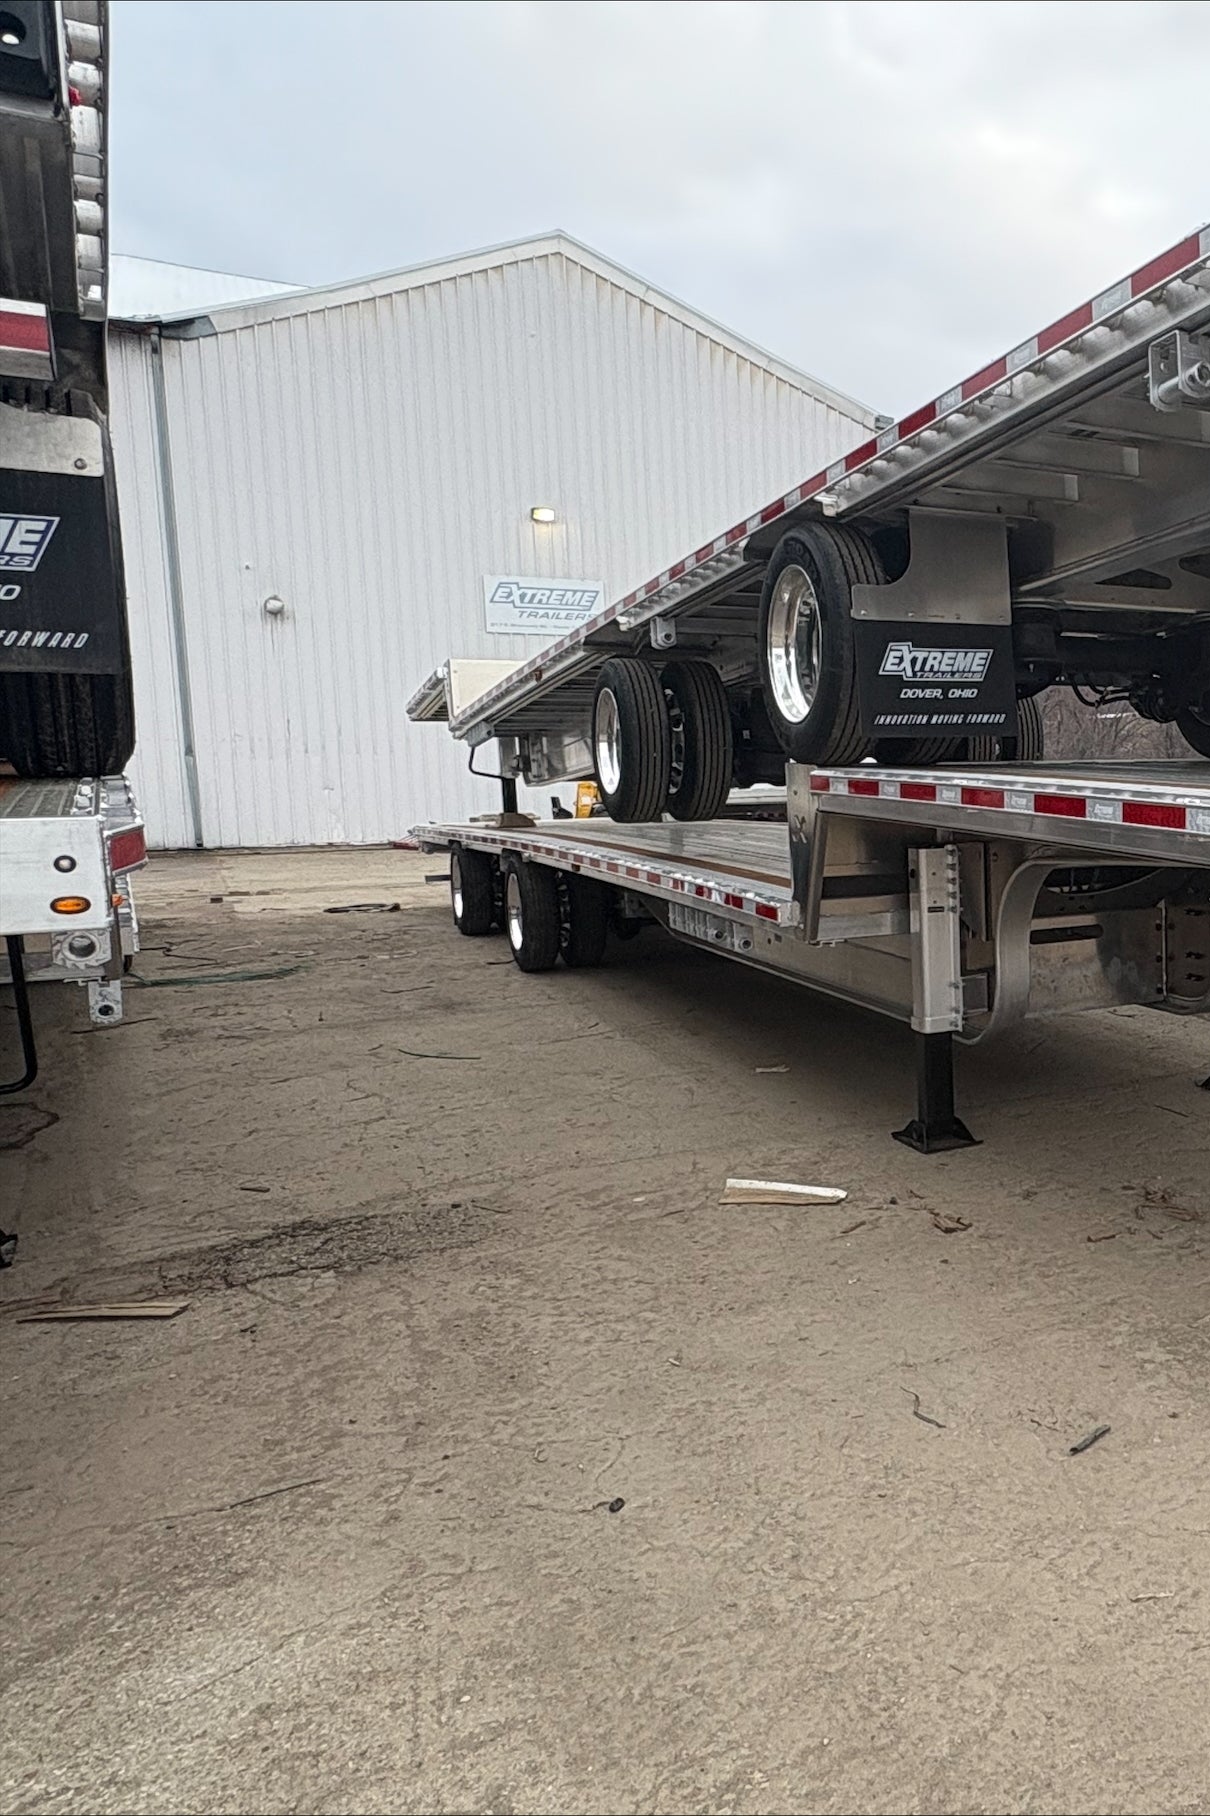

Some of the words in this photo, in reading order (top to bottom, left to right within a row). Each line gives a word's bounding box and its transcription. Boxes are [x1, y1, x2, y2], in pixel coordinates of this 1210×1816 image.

[492, 584, 598, 608] EXTREME
[884, 645, 989, 677] EXTREME
[916, 671, 983, 679] TRAILERS
[900, 688, 944, 700] DOVER,
[947, 688, 979, 699] OHIO
